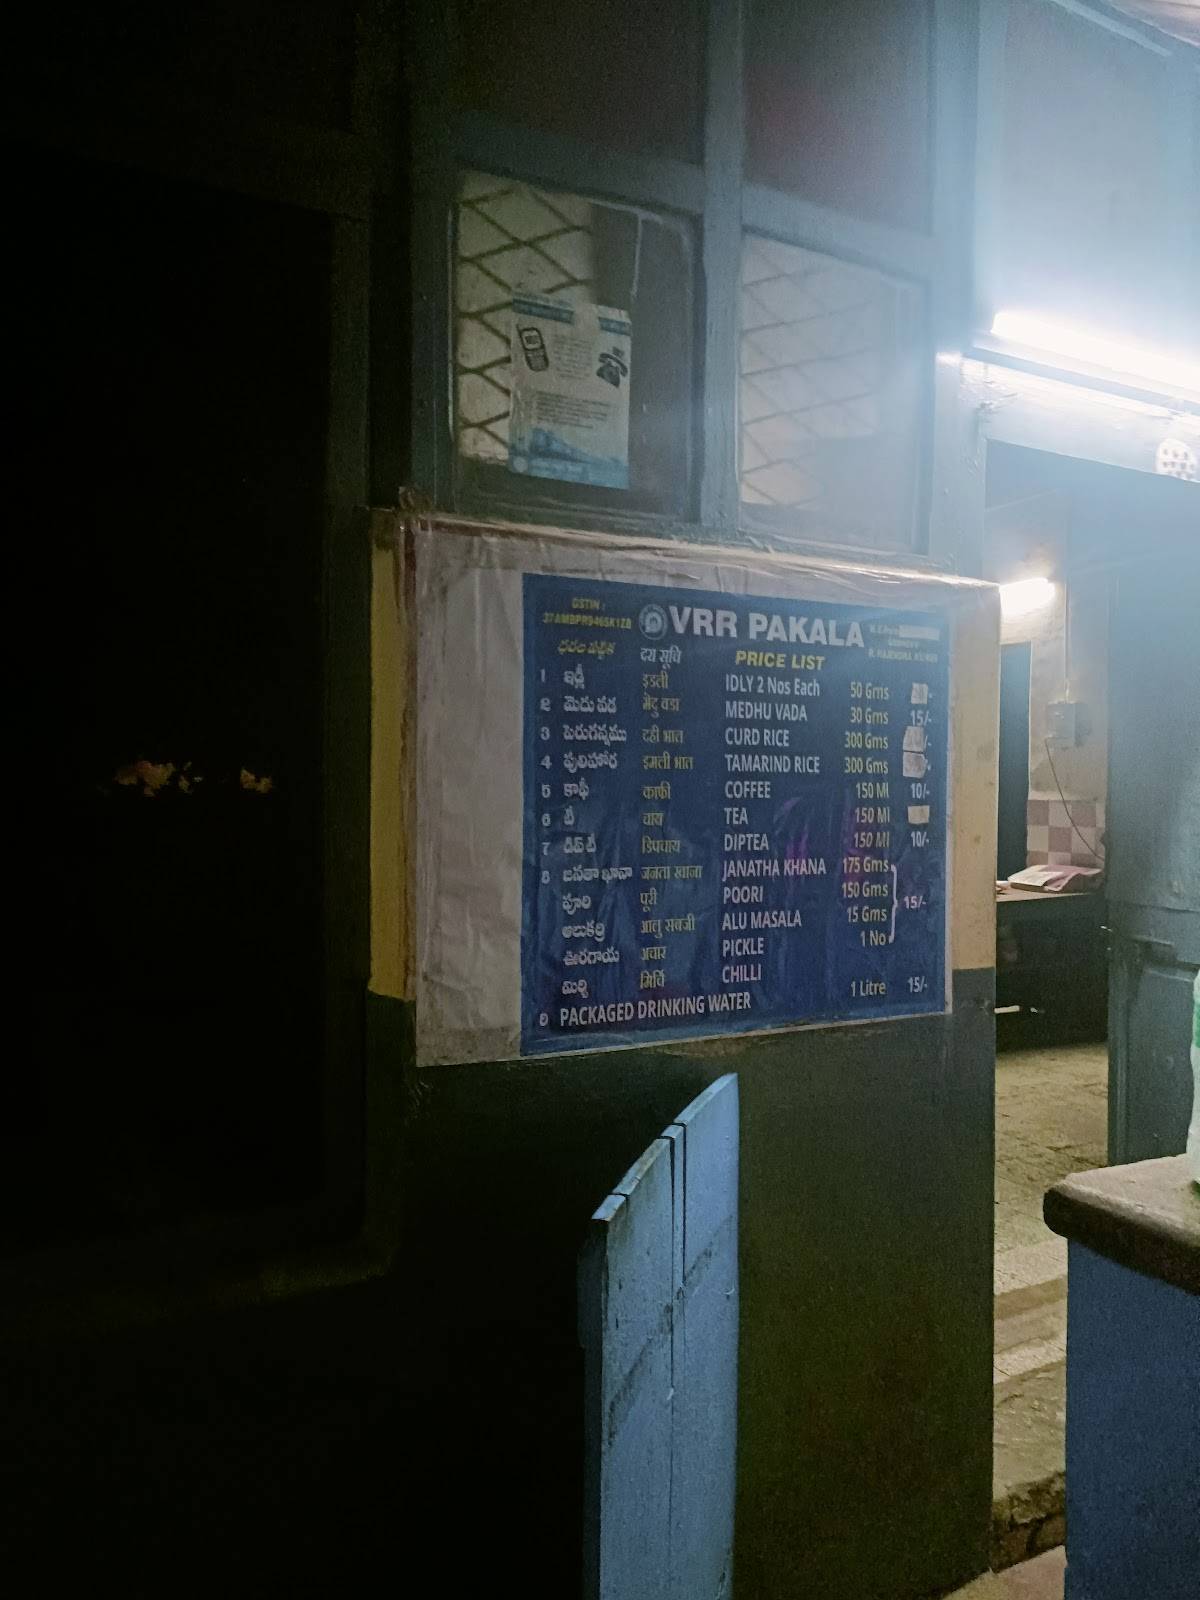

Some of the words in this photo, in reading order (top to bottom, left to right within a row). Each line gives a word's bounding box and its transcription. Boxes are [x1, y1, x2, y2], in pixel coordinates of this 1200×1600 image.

[669, 605, 737, 639] VRR
[748, 612, 864, 648] PAKALA
[736, 650, 786, 668] PRICE
[792, 654, 826, 671] LIST
[725, 674, 753, 693] IDLY
[757, 676, 764, 694] 2
[767, 676, 791, 695] Nos
[794, 677, 820, 697] Each
[850, 682, 863, 698] 50
[865, 683, 889, 700] Gms
[540, 698, 551, 712] 2
[725, 701, 771, 720] MEDHU
[775, 703, 808, 721] VADA
[850, 707, 863, 723] 30
[865, 708, 889, 726] Gms
[910, 709, 932, 726] 15/-
[540, 727, 550, 740] 3
[725, 727, 760, 745] CURD
[764, 729, 790, 747] RICE
[844, 732, 863, 749] 300
[865, 733, 889, 750] Gms
[540, 755, 552, 770] 4
[725, 754, 791, 773] TAMARIND
[794, 756, 820, 774] RICE
[844, 757, 863, 774] 300
[865, 757, 889, 774] Gms
[541, 784, 551, 798] 5
[724, 781, 771, 799] COFFEE
[856, 783, 874, 798] 150
[910, 783, 930, 799] 10/-
[541, 813, 551, 827] 6
[724, 807, 748, 825] TEA
[855, 807, 875, 824] 150
[541, 842, 550, 855] 7
[724, 834, 769, 852] DIPTEA
[854, 832, 875, 848] 150
[910, 832, 930, 848] 10/-
[722, 860, 780, 882] JANATHA
[784, 858, 827, 876] KHANA
[843, 857, 861, 873] 175
[863, 856, 889, 873] Gms
[723, 886, 764, 904] POORI
[842, 883, 860, 898] 150
[862, 882, 888, 897] Gms
[903, 895, 927, 910] 15/-
[722, 912, 747, 931] ALU
[750, 911, 802, 929] MASALA
[846, 907, 859, 923] 15
[861, 907, 887, 922] Gms
[860, 932, 866, 946] 1
[869, 930, 887, 946] No
[722, 937, 764, 957] PICKLE
[722, 964, 761, 984] CHILLI
[850, 981, 856, 997] 1
[859, 980, 886, 996] Litre
[908, 977, 928, 993] 15/-
[560, 1002, 634, 1027] PACKAGED
[637, 995, 705, 1019] DRINKING
[708, 991, 751, 1012] WATER
